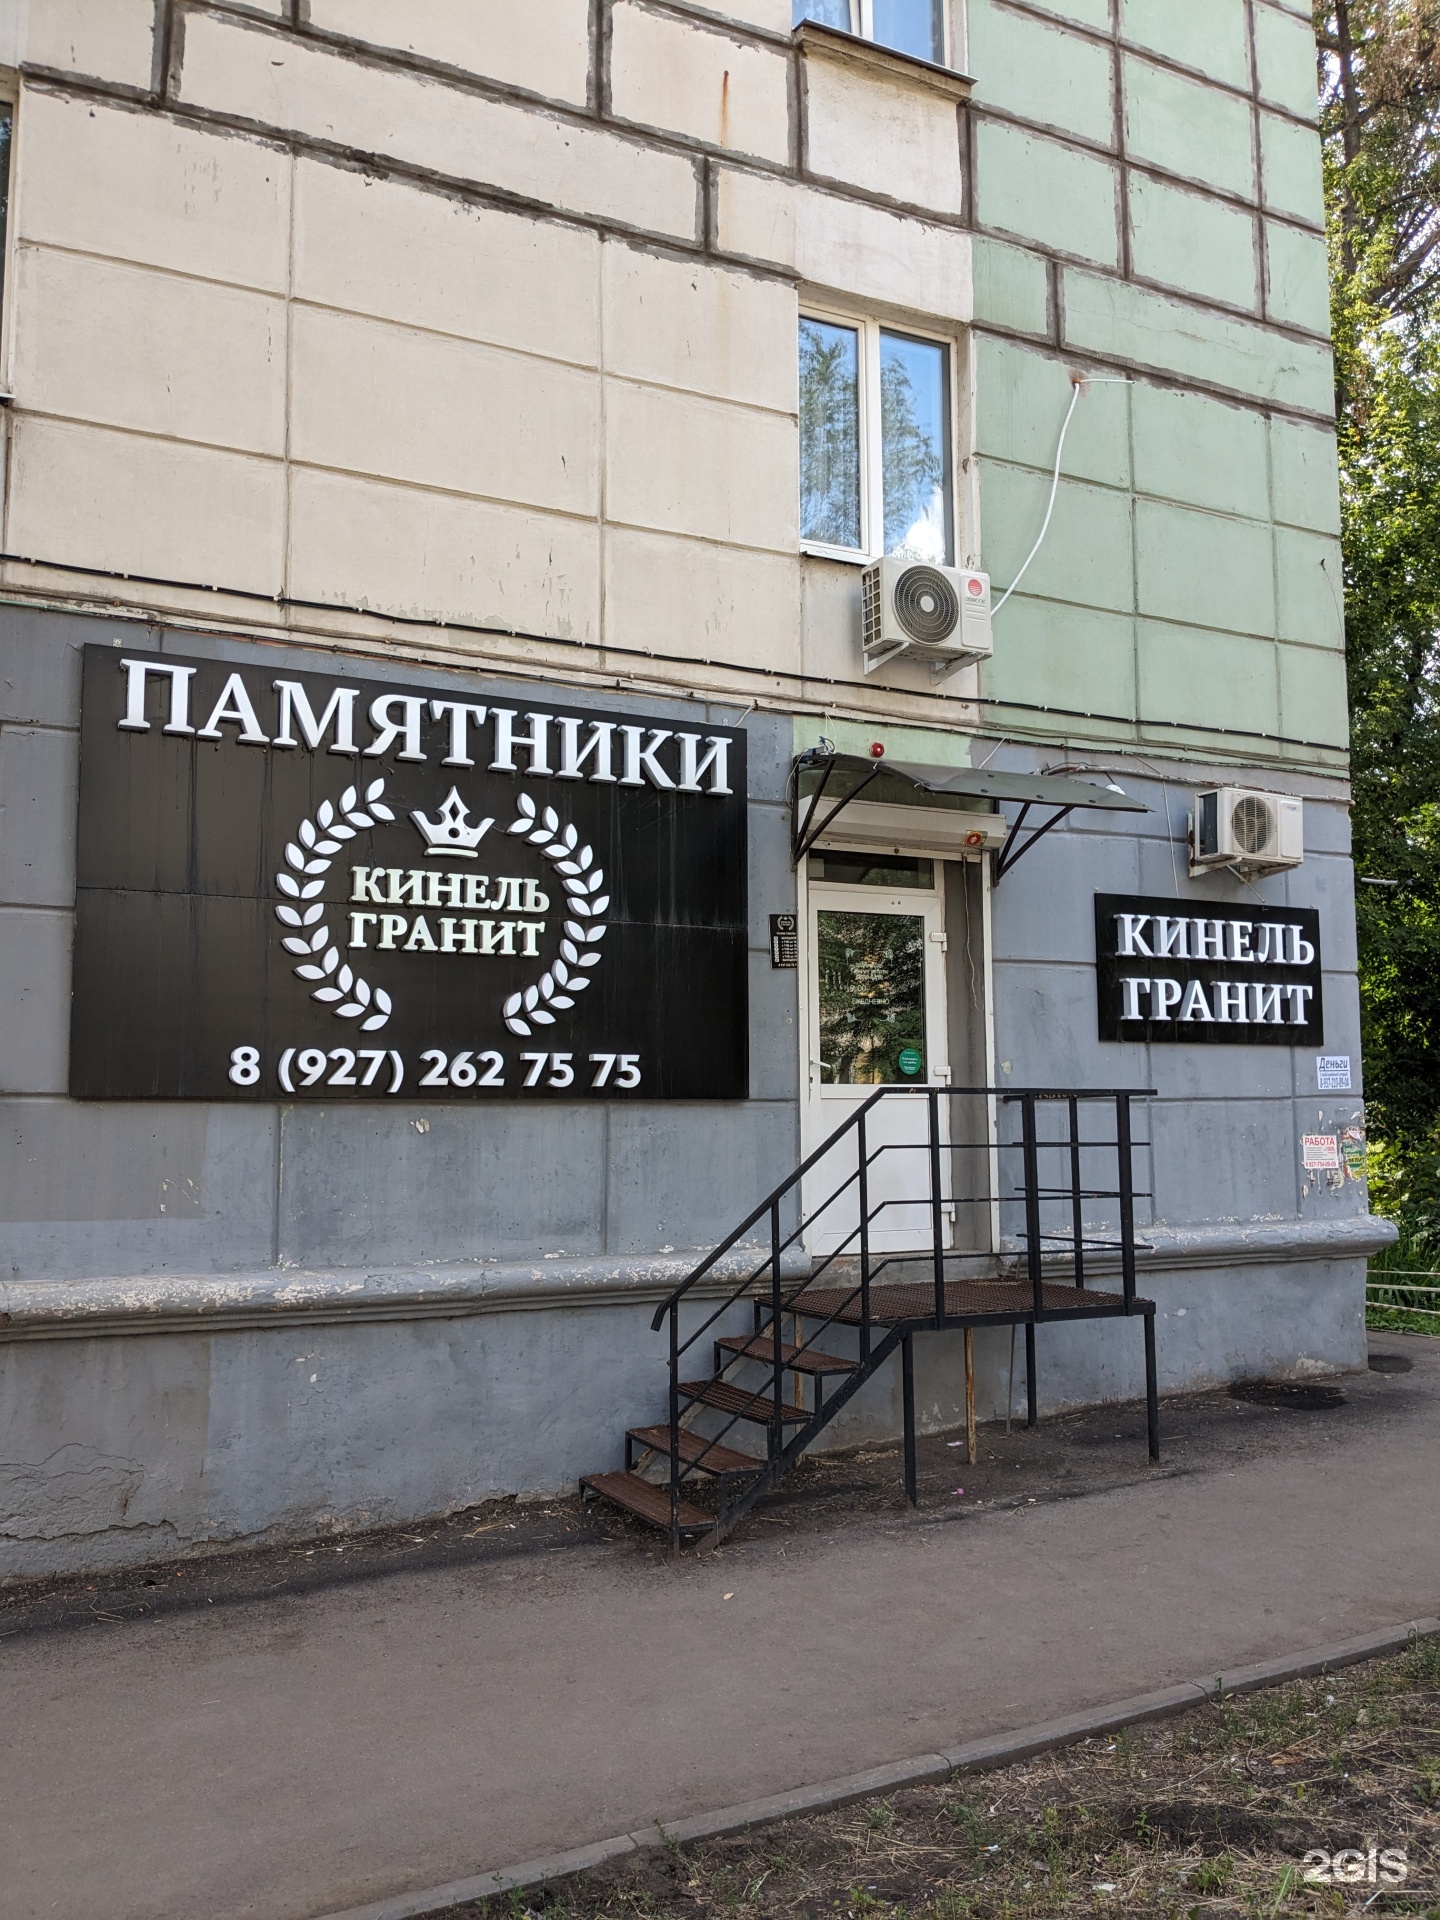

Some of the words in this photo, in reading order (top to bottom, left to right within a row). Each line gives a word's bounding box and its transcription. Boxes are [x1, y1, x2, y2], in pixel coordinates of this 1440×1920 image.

[118, 658, 733, 796] ПАМЯТНИКИ
[349, 866, 550, 914] КИНЕЛЬ
[348, 912, 546, 957] ГРАНИТ
[1113, 913, 1315, 965] КИНЕЛЬ
[1118, 977, 1313, 1025] ГРАНИТ
[229, 1046, 261, 1087] 8
[278, 1047, 404, 1093] (927)
[419, 1050, 505, 1088] 262
[520, 1052, 575, 1089] 75
[589, 1053, 641, 1090] 75
[1319, 1057, 1348, 1071] Деньги
[1304, 1137, 1335, 1146] РАБОТА
